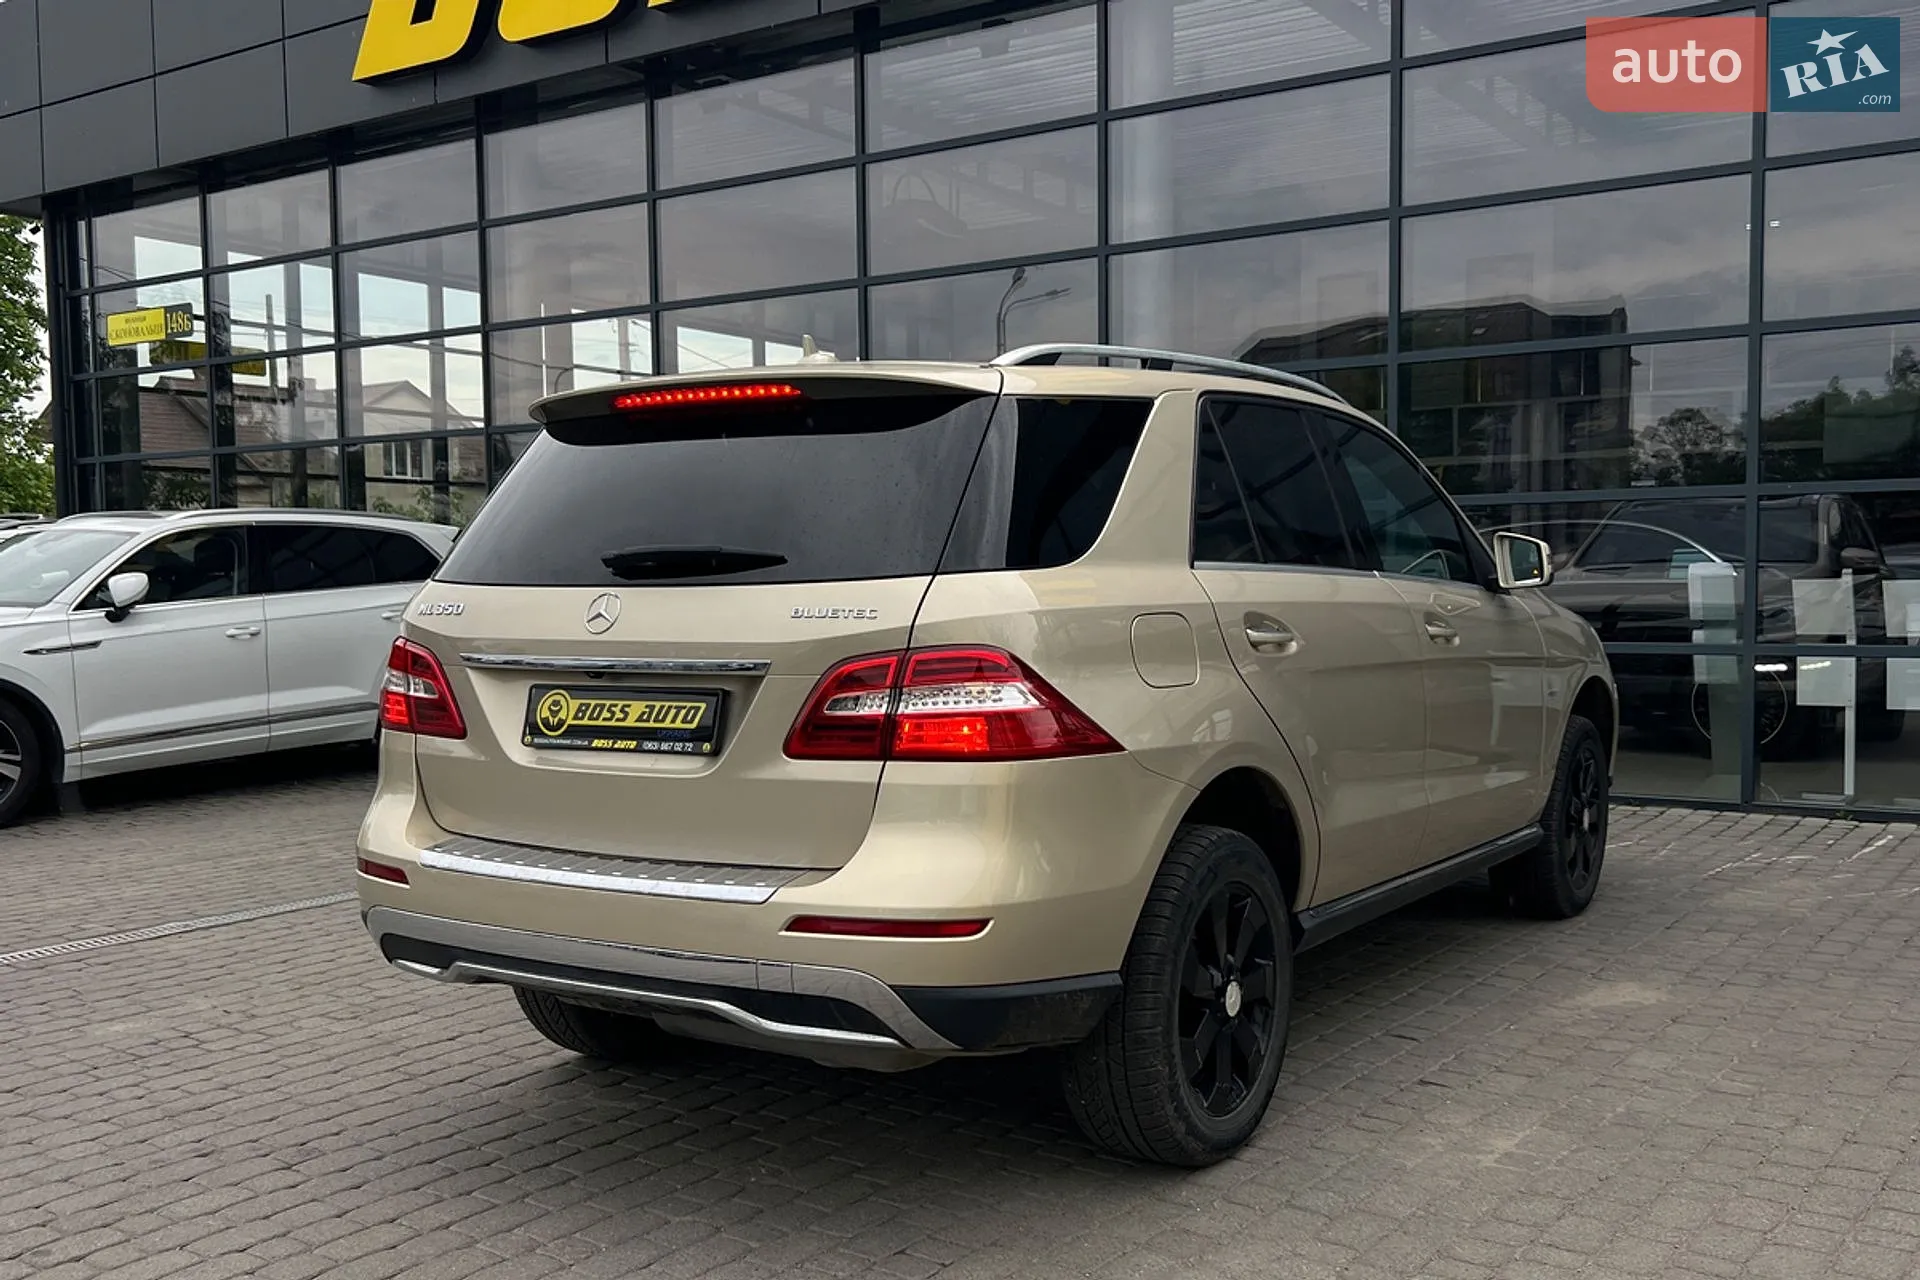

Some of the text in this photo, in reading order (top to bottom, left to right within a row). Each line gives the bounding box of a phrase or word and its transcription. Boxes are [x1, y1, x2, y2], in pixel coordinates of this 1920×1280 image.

[790, 607, 879, 619] BLUETEC
[572, 702, 702, 724] BOSS AUTO
